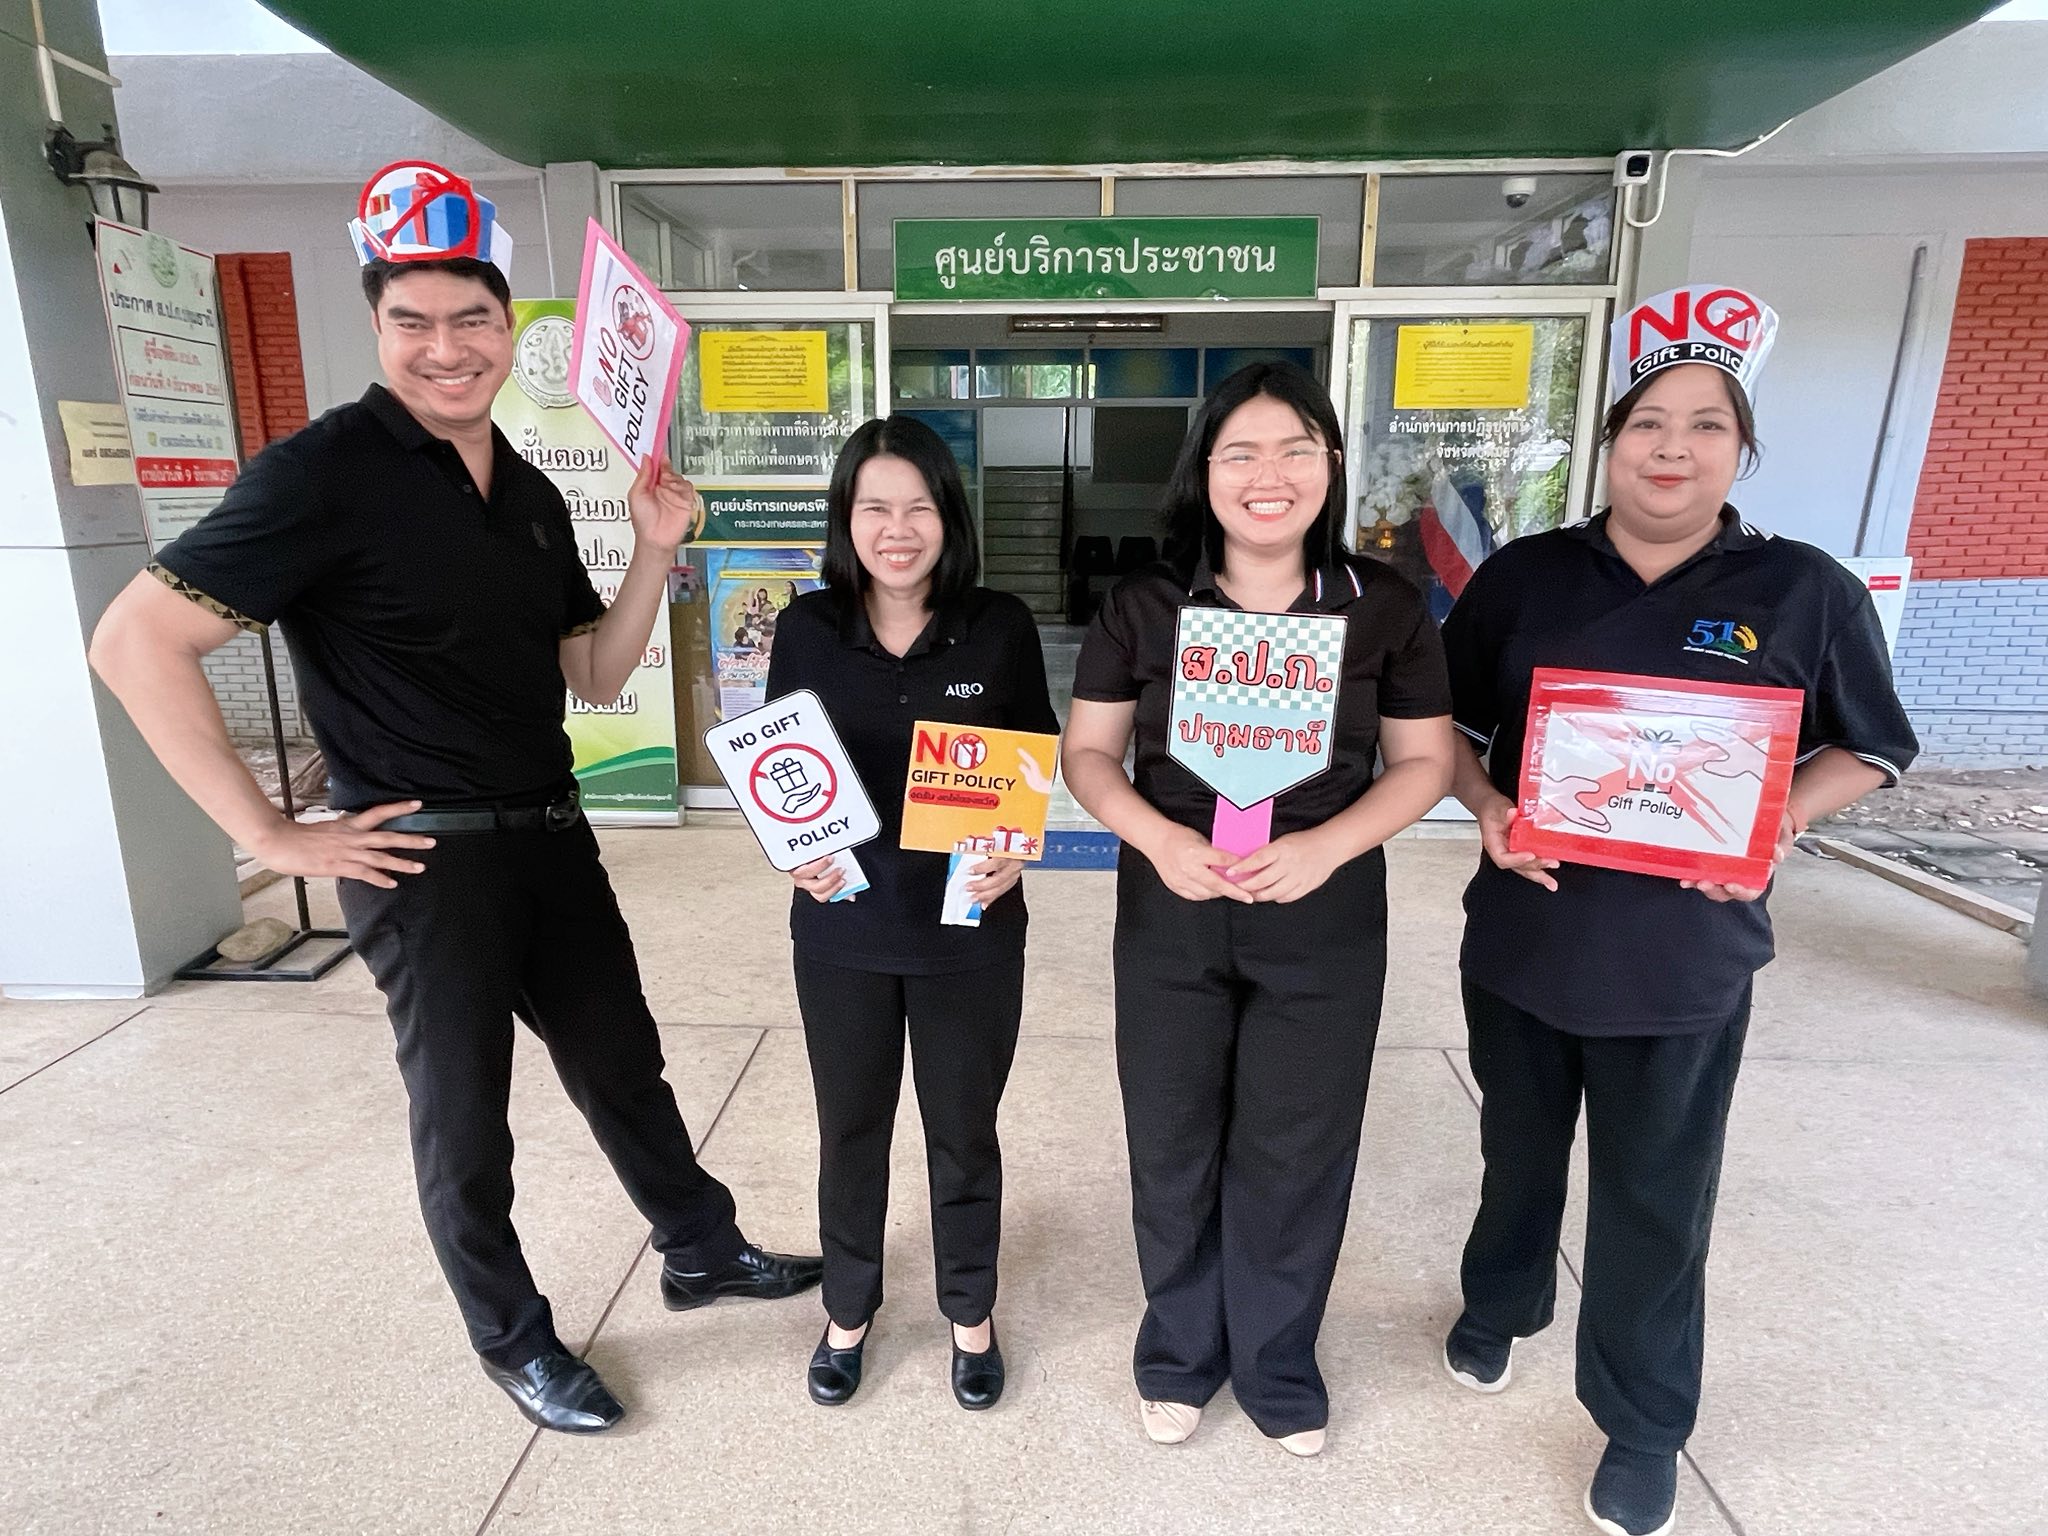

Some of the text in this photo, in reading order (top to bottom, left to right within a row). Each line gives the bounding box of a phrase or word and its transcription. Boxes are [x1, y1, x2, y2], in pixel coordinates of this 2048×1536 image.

[935, 232, 1276, 289] ศูนย์บริการประชาชน
[598, 326, 617, 386] NO
[1636, 344, 1743, 374] Gift Polic
[614, 350, 634, 410] GIFT
[624, 367, 650, 457] POLICY
[522, 427, 607, 467] ขั้นตอน
[581, 537, 628, 567] ป.ก.
[1686, 619, 1736, 646] 51
[1181, 640, 1333, 692] ส.ป.ก.
[945, 682, 984, 698] ALRO
[728, 712, 802, 753] NO GIFT
[1179, 712, 1327, 758] ปทุมธานี
[911, 769, 1017, 791] GIFT POLICY
[1627, 752, 1676, 784] No
[1607, 795, 1684, 819] Gift Policy
[787, 816, 850, 852] POLICY
